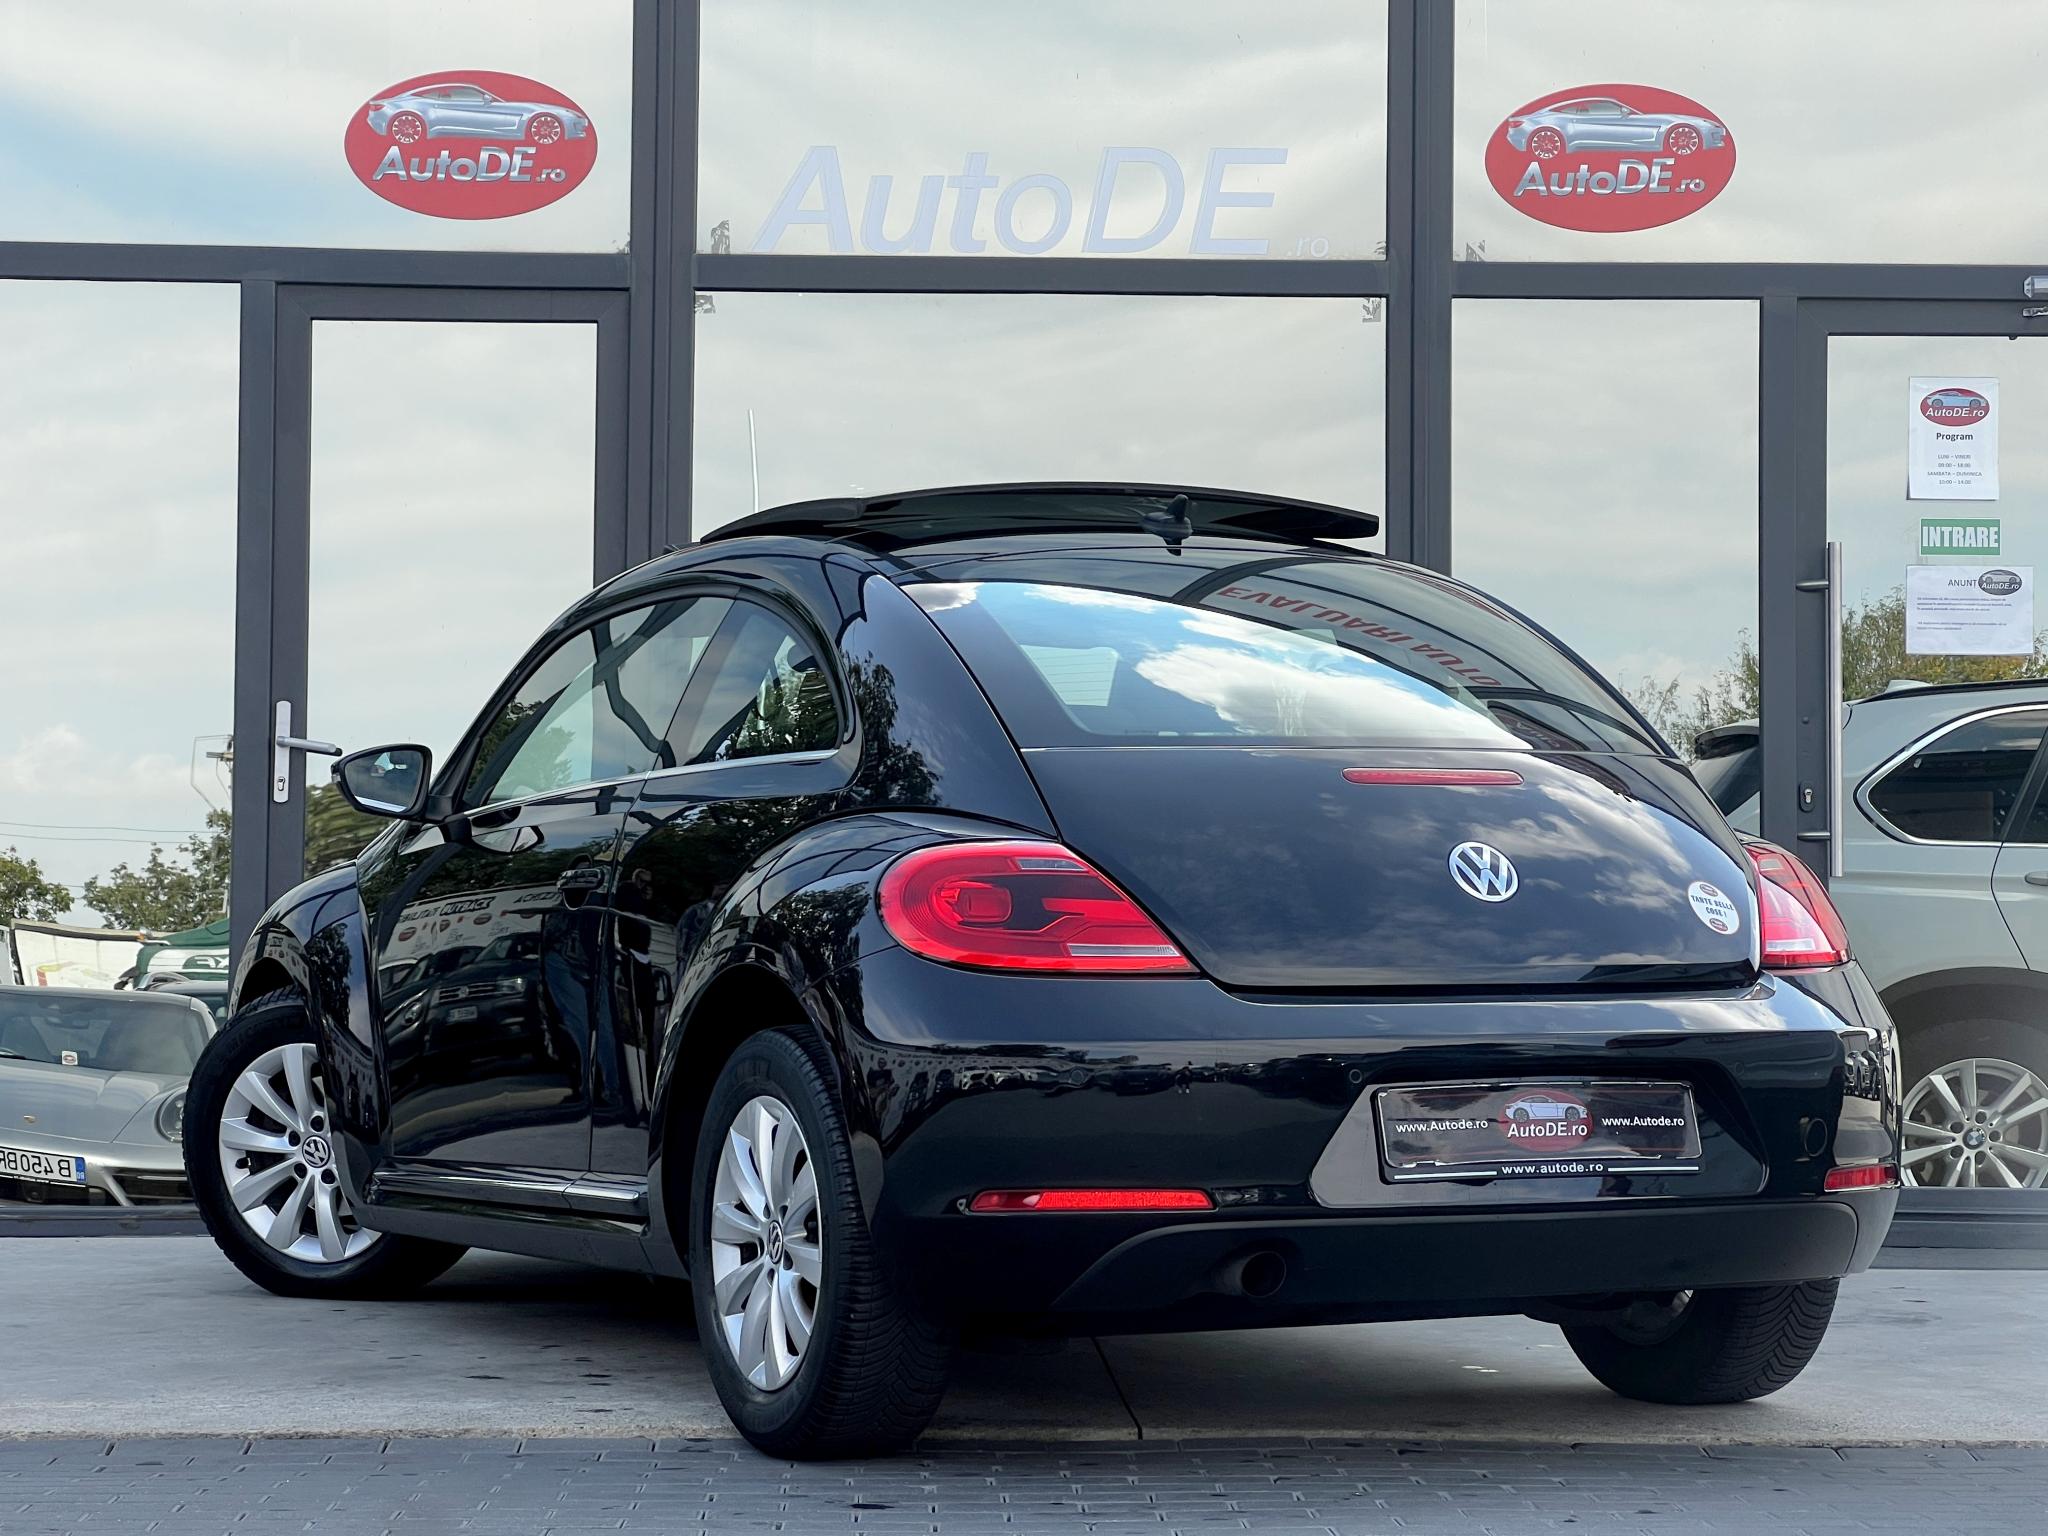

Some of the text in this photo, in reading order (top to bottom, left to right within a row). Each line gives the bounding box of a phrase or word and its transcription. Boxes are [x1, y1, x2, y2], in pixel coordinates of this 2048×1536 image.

[1936, 432, 1974, 442] Program
[1922, 526, 1999, 548] INTRARE
[1690, 894, 1713, 906] TANTE
[1395, 1118, 1488, 1134] www.Autode.ro
[1601, 1115, 1685, 1128] www.Autode.ro
[1507, 1121, 1588, 1139] AutoDE.ro
[1501, 1161, 1604, 1176] www.autode.ro
